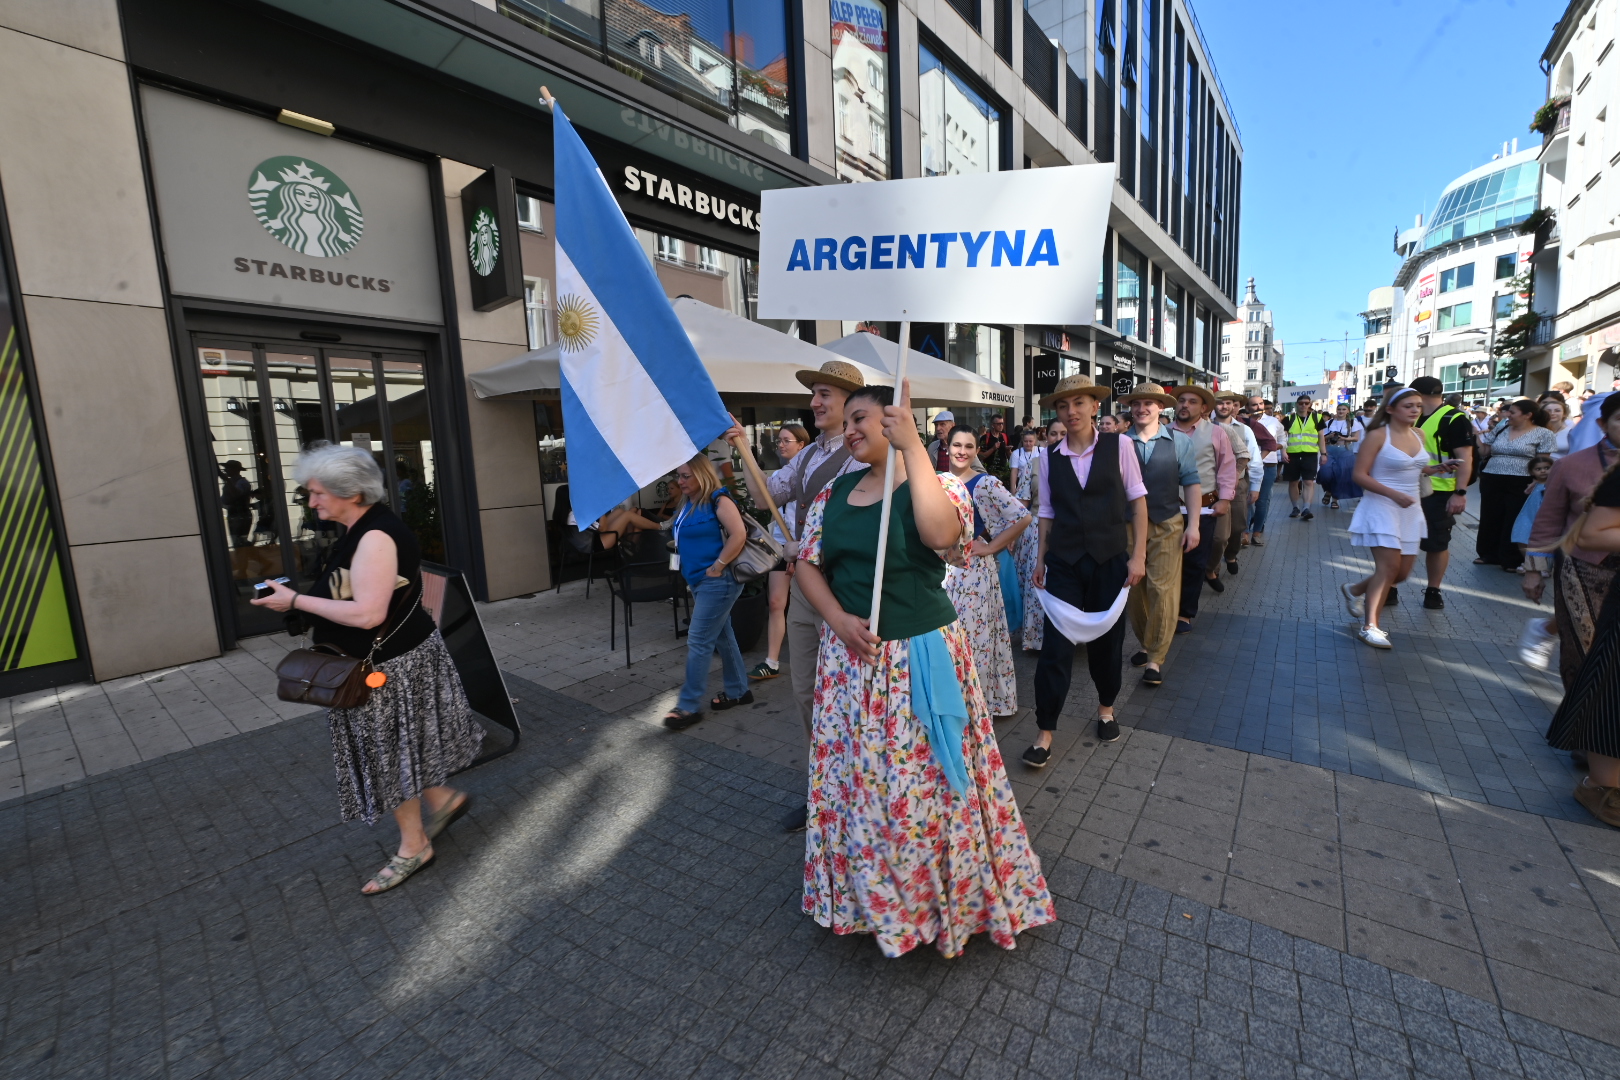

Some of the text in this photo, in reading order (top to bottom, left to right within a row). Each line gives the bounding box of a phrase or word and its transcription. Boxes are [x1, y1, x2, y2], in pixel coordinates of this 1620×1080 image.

[831, 0, 853, 23] KLEP
[786, 228, 1060, 271] ARGENTYNA
[233, 256, 391, 293] STARBUCKS
[1044, 330, 1061, 350] ING
[1037, 369, 1056, 379] ING
[981, 390, 1015, 404] STARBUCKS
